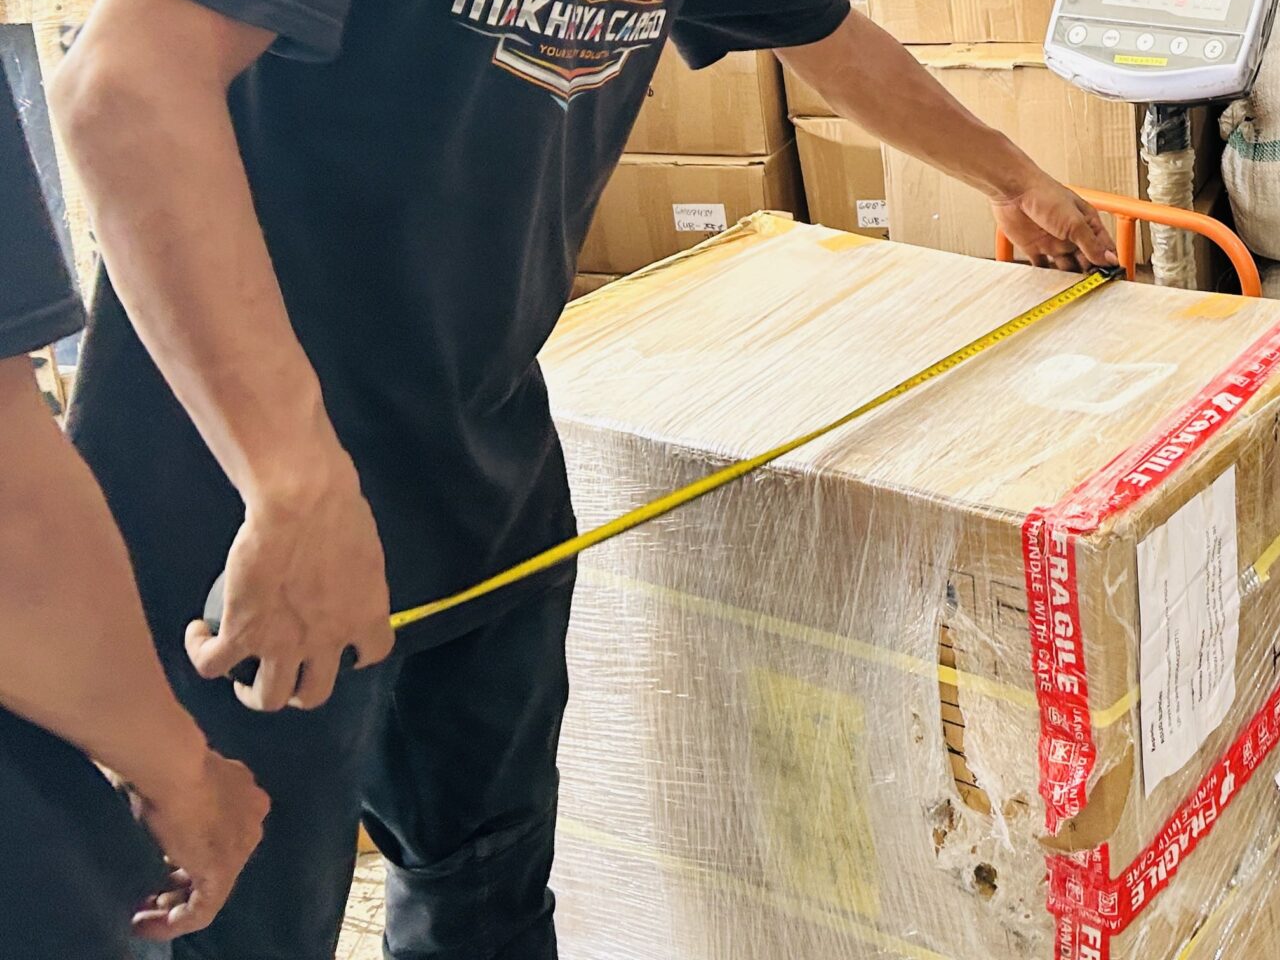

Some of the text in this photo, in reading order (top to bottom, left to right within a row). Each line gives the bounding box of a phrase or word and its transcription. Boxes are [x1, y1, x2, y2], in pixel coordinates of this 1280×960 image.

[1122, 406, 1223, 489] FRAGILE
[1034, 599, 1047, 643] WITH
[1050, 527, 1080, 696] FRAGILE
[1131, 796, 1218, 912] FRAGILE
